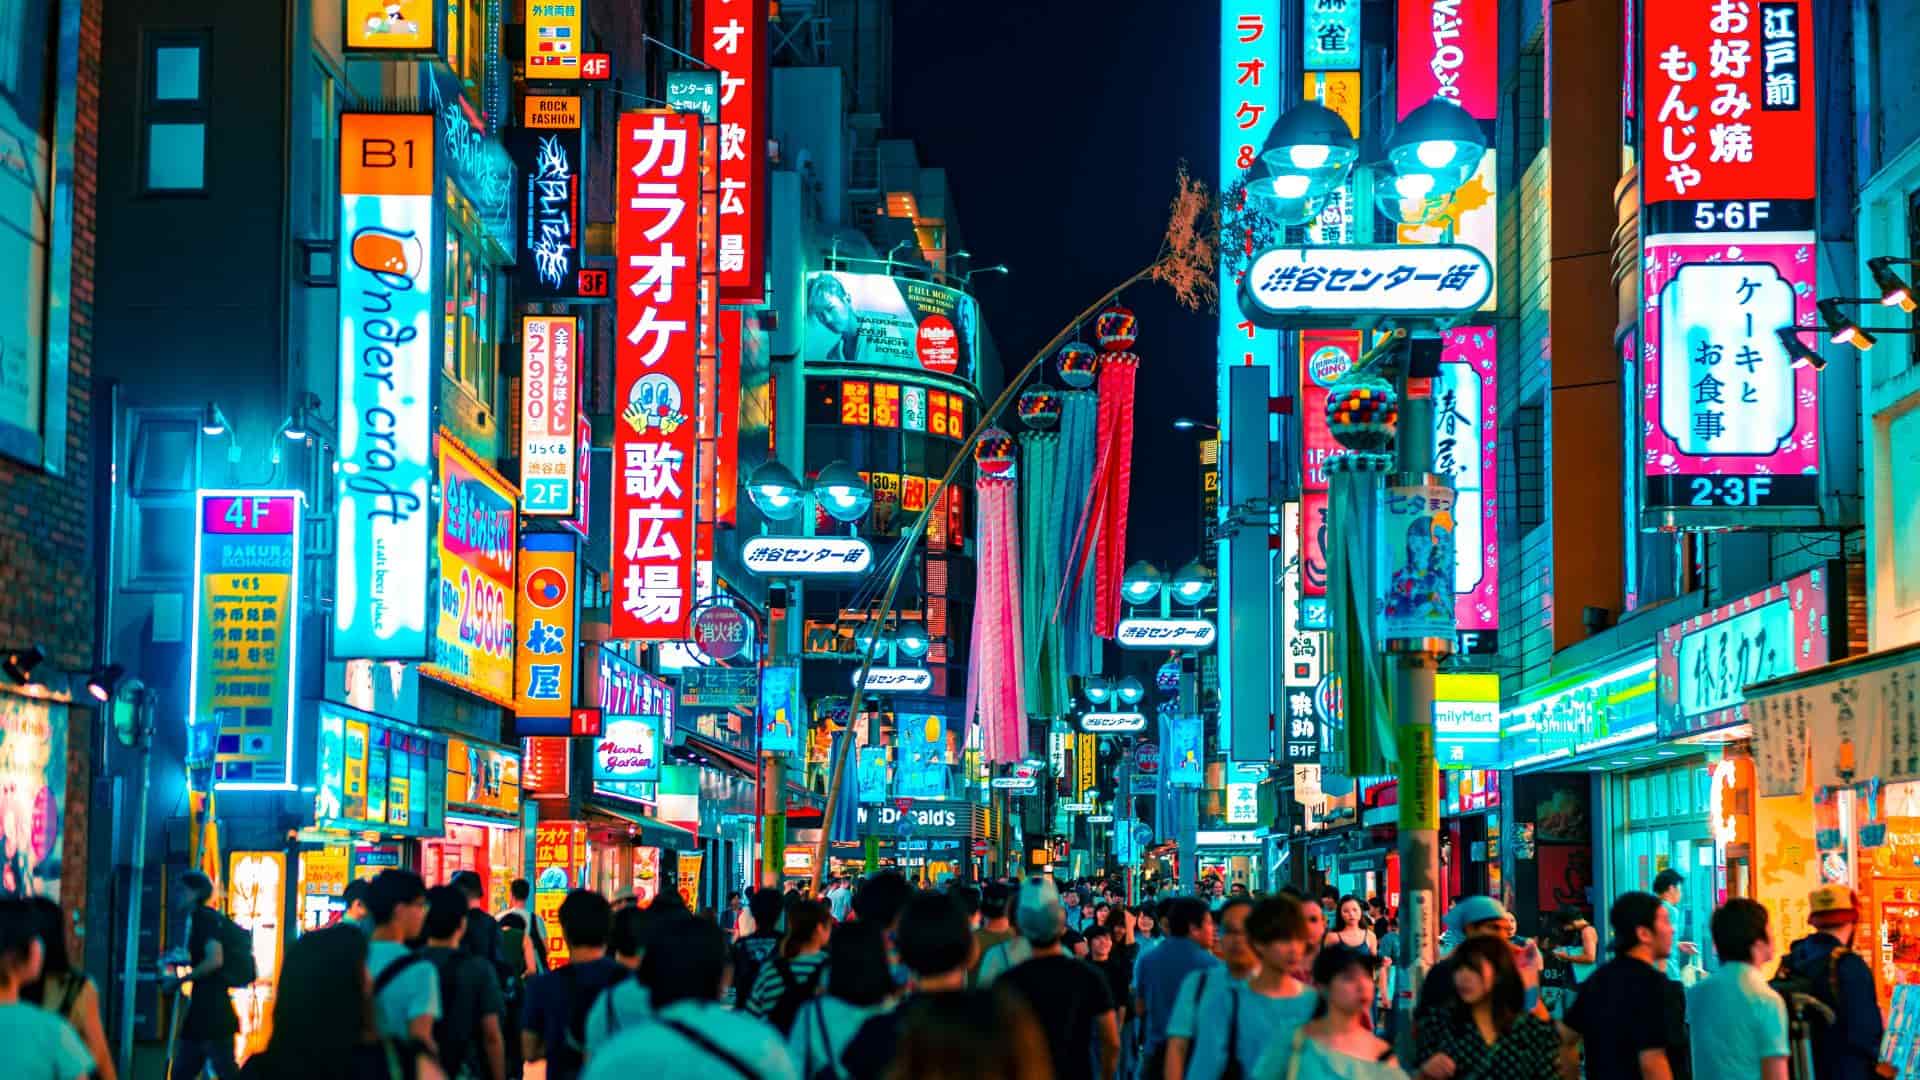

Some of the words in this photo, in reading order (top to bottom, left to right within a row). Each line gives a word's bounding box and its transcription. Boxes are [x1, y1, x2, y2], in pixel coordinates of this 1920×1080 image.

[583, 58, 607, 75] 4F
[1764, 7, 1796, 106] 江戸前
[1709, 1, 1753, 163] お好み焼
[539, 101, 567, 112] ROCK
[531, 114, 576, 125] FASHION
[1658, 45, 1702, 194] もんじゃ
[361, 138, 416, 169] B1
[628, 117, 687, 368] カラオケ
[583, 274, 605, 292] 3F
[1260, 264, 1481, 292] 渋谷センター街
[1735, 277, 1763, 403] ケーキと
[1317, 363, 1346, 379] KING
[1693, 340, 1726, 441] お食事
[528, 442, 567, 454] りっくる
[531, 483, 564, 504] 2F
[224, 497, 270, 528] 4F
[623, 442, 684, 624] 歌広場
[748, 547, 866, 563] 渋谷センター街
[699, 622, 744, 643] 消火栓
[1123, 626, 1212, 639] 渋谷センター街
[1455, 633, 1480, 654] F
[526, 619, 566, 700] 松屋
[596, 742, 643, 755] Miami
[1290, 745, 1316, 756] B1F
[604, 756, 653, 773] Garden
